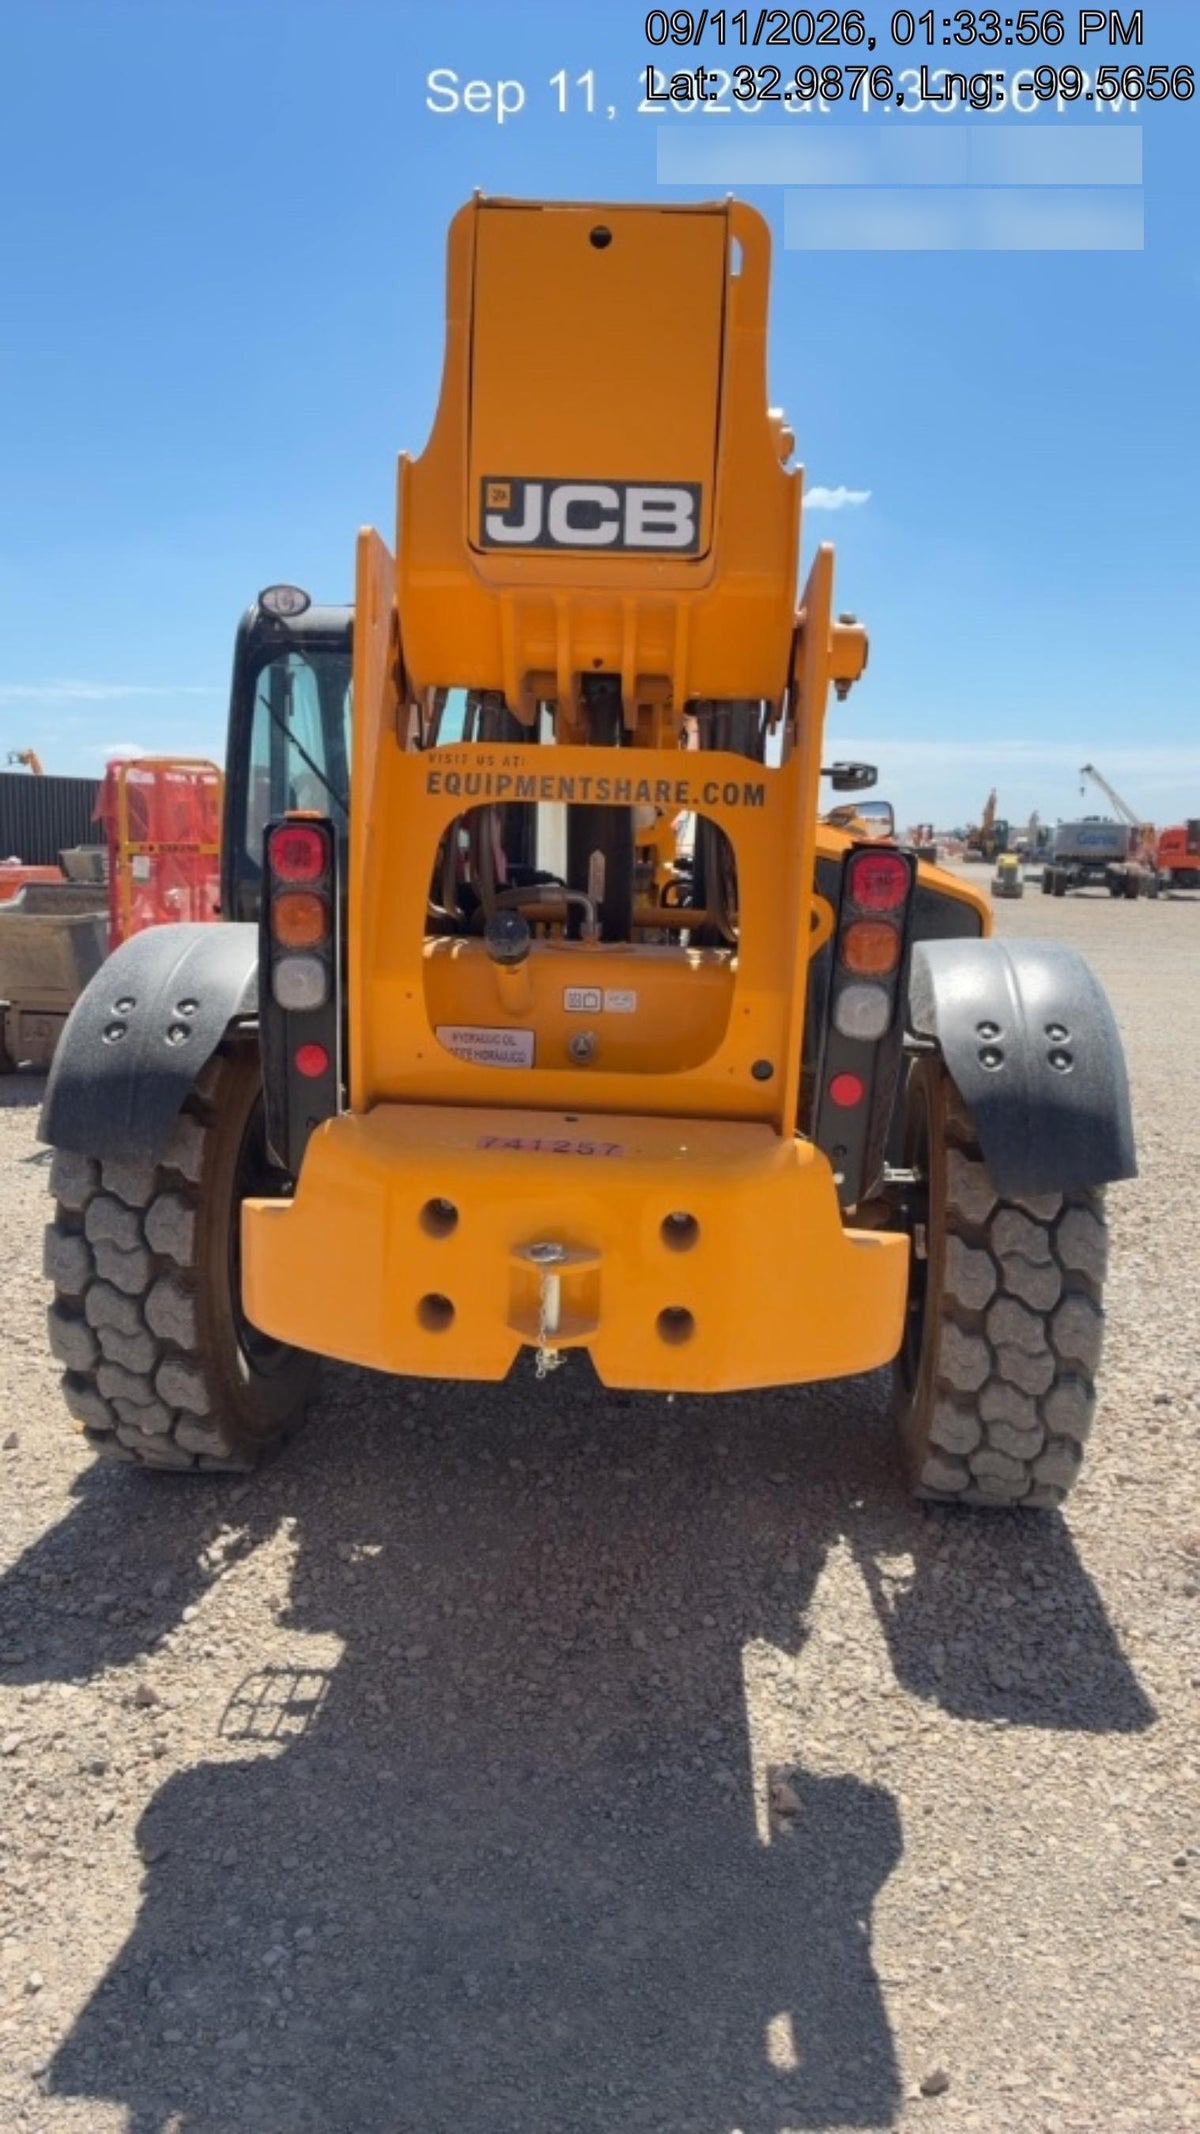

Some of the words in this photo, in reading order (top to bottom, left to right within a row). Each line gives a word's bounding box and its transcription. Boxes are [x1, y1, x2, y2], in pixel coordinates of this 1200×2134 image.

[485, 483, 696, 547] JCB
[428, 753, 468, 765] VISIT
[476, 754, 495, 766] US
[426, 771, 766, 807] EQUIPMENTSHARE.COM
[482, 1136, 621, 1156] 741257
